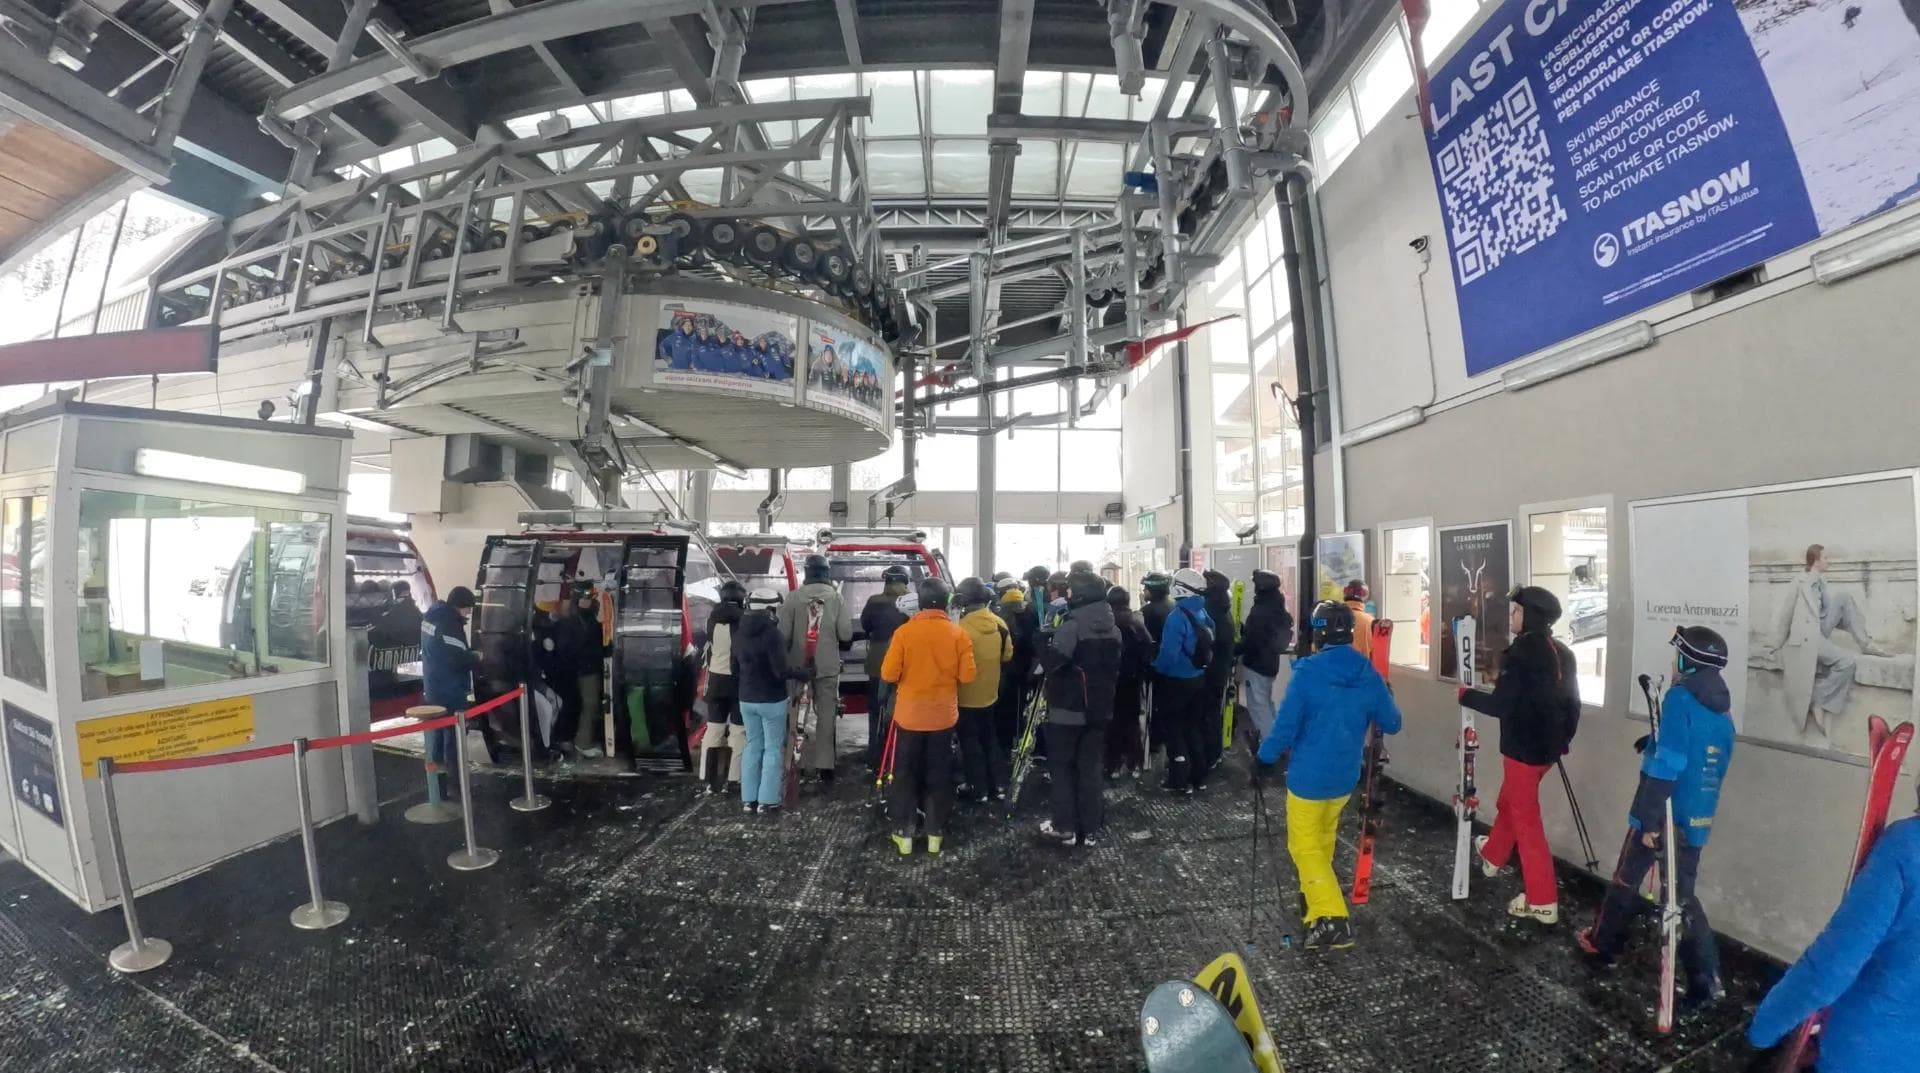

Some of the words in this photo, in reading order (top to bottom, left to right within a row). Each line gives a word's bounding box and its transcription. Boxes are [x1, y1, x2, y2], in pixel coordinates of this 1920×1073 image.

[1540, 0, 1620, 69] L'ASSICURAZI
[1548, 75, 1568, 94] SEI
[1568, 19, 1631, 77] COPERTO?
[1553, 55, 1618, 110] INQUADRA
[1617, 44, 1631, 59] IL
[1631, 25, 1652, 46] QR
[1557, 102, 1582, 124] PER
[1583, 51, 1643, 106] ATTIVARE
[1643, 0, 1714, 57] ITASNOW.
[1430, 24, 1514, 132] LAST
[1543, 68, 1553, 81] È
[1566, 131, 1587, 152] SKI
[1587, 79, 1661, 137] INSURANCE
[1570, 153, 1583, 167] IS
[1584, 96, 1664, 158] MANDATORY.
[1575, 158, 1599, 181] ARE
[1599, 140, 1627, 164] YOU
[1628, 89, 1701, 145] COVERED?
[1579, 169, 1615, 199] SCAN
[1615, 152, 1642, 176] THE
[1643, 138, 1665, 158] QR
[1666, 110, 1709, 144] CODE
[1581, 196, 1601, 213] TO
[1603, 157, 1665, 203] ACTIVATE
[1665, 114, 1739, 165] ITASNOW.
[1622, 159, 1750, 247] ITASNOW
[1626, 240, 1654, 257] Instant
[1655, 219, 1695, 243] insurance
[1695, 213, 1707, 225] by
[1708, 200, 1729, 217] ITAS
[1729, 187, 1760, 207] Mutua
[1138, 514, 1154, 534] EXIT
[1453, 532, 1494, 543] STEAKHOUSE
[1646, 600, 1681, 615] Lorena
[1682, 603, 1739, 617] Antoniazzi
